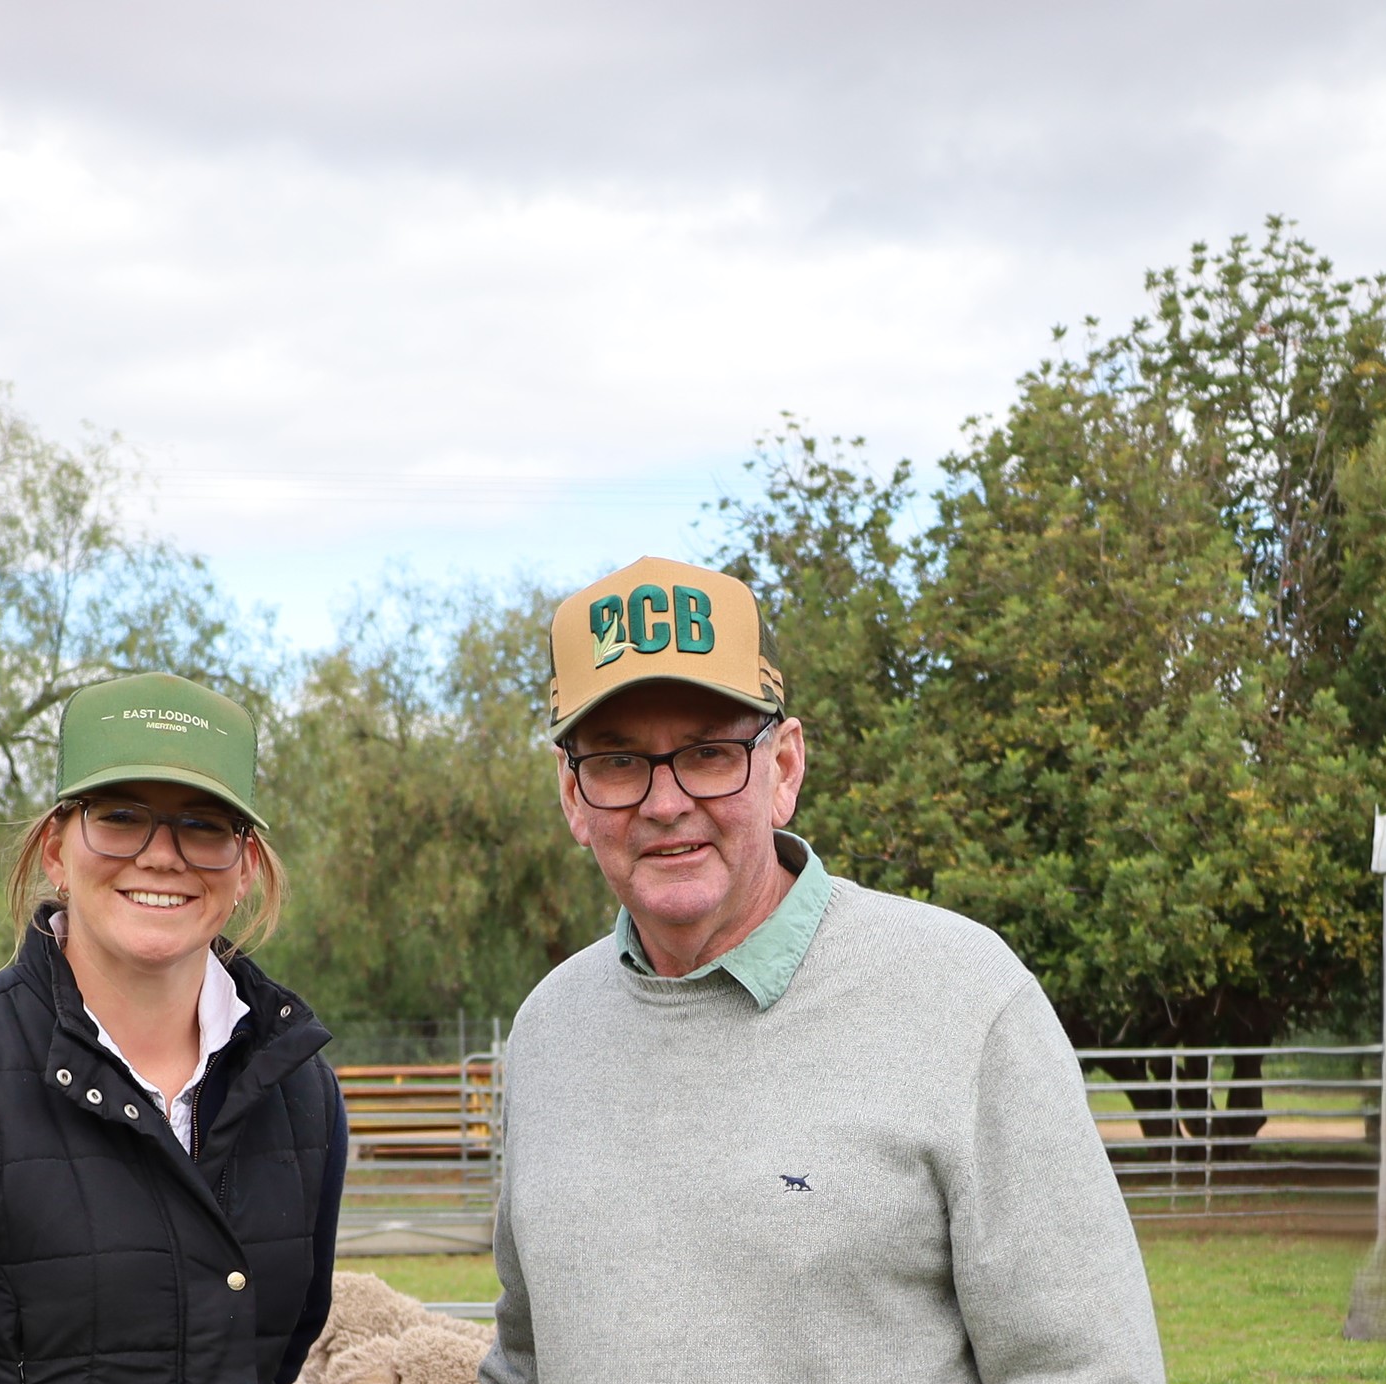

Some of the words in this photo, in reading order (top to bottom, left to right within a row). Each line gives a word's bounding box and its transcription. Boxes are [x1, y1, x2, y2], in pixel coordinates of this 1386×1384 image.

[123, 709, 156, 719] EAST
[158, 709, 209, 730] LODDON
[146, 721, 188, 733] MERINOS
